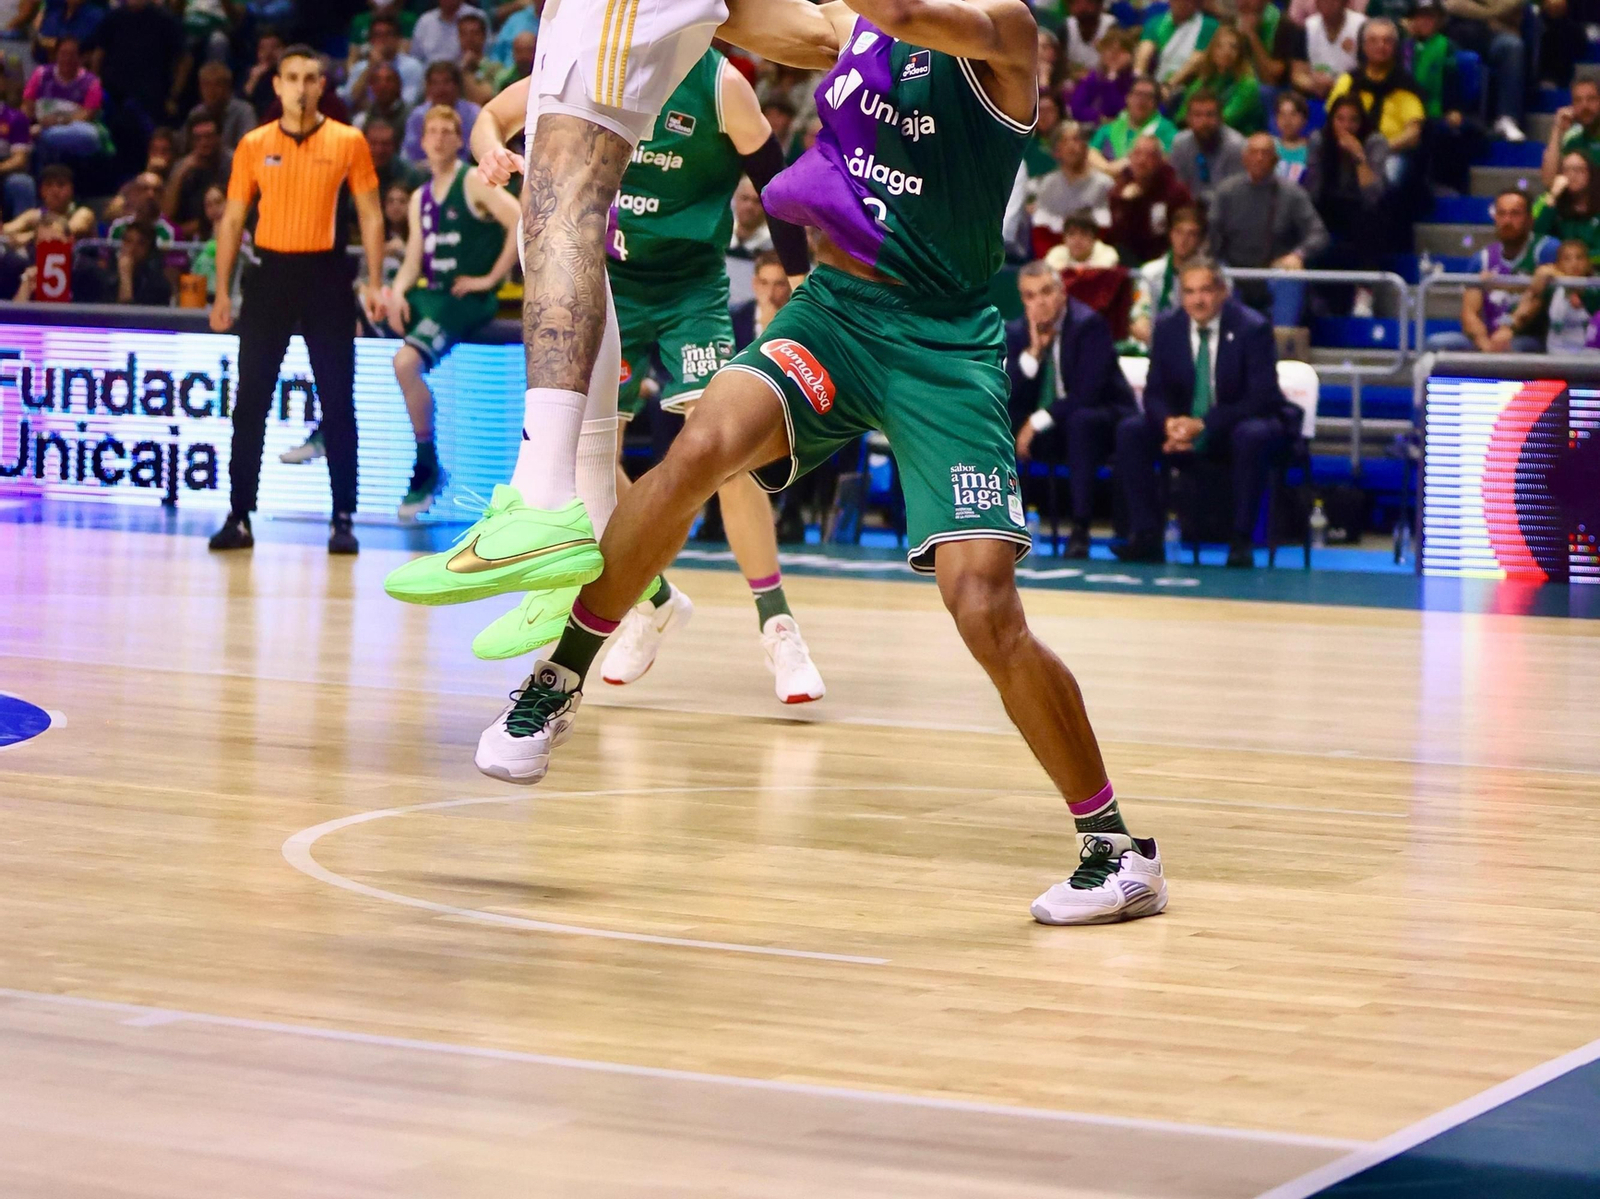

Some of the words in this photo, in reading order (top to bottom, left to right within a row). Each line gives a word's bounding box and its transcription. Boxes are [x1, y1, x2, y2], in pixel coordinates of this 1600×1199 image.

[41, 253, 67, 297] 5
[0, 350, 318, 422] Fundacin
[767, 342, 831, 411] famadesa
[950, 462, 976, 473] sabor
[951, 473, 959, 483] a
[960, 466, 1002, 491] má
[953, 484, 1004, 510] laga
